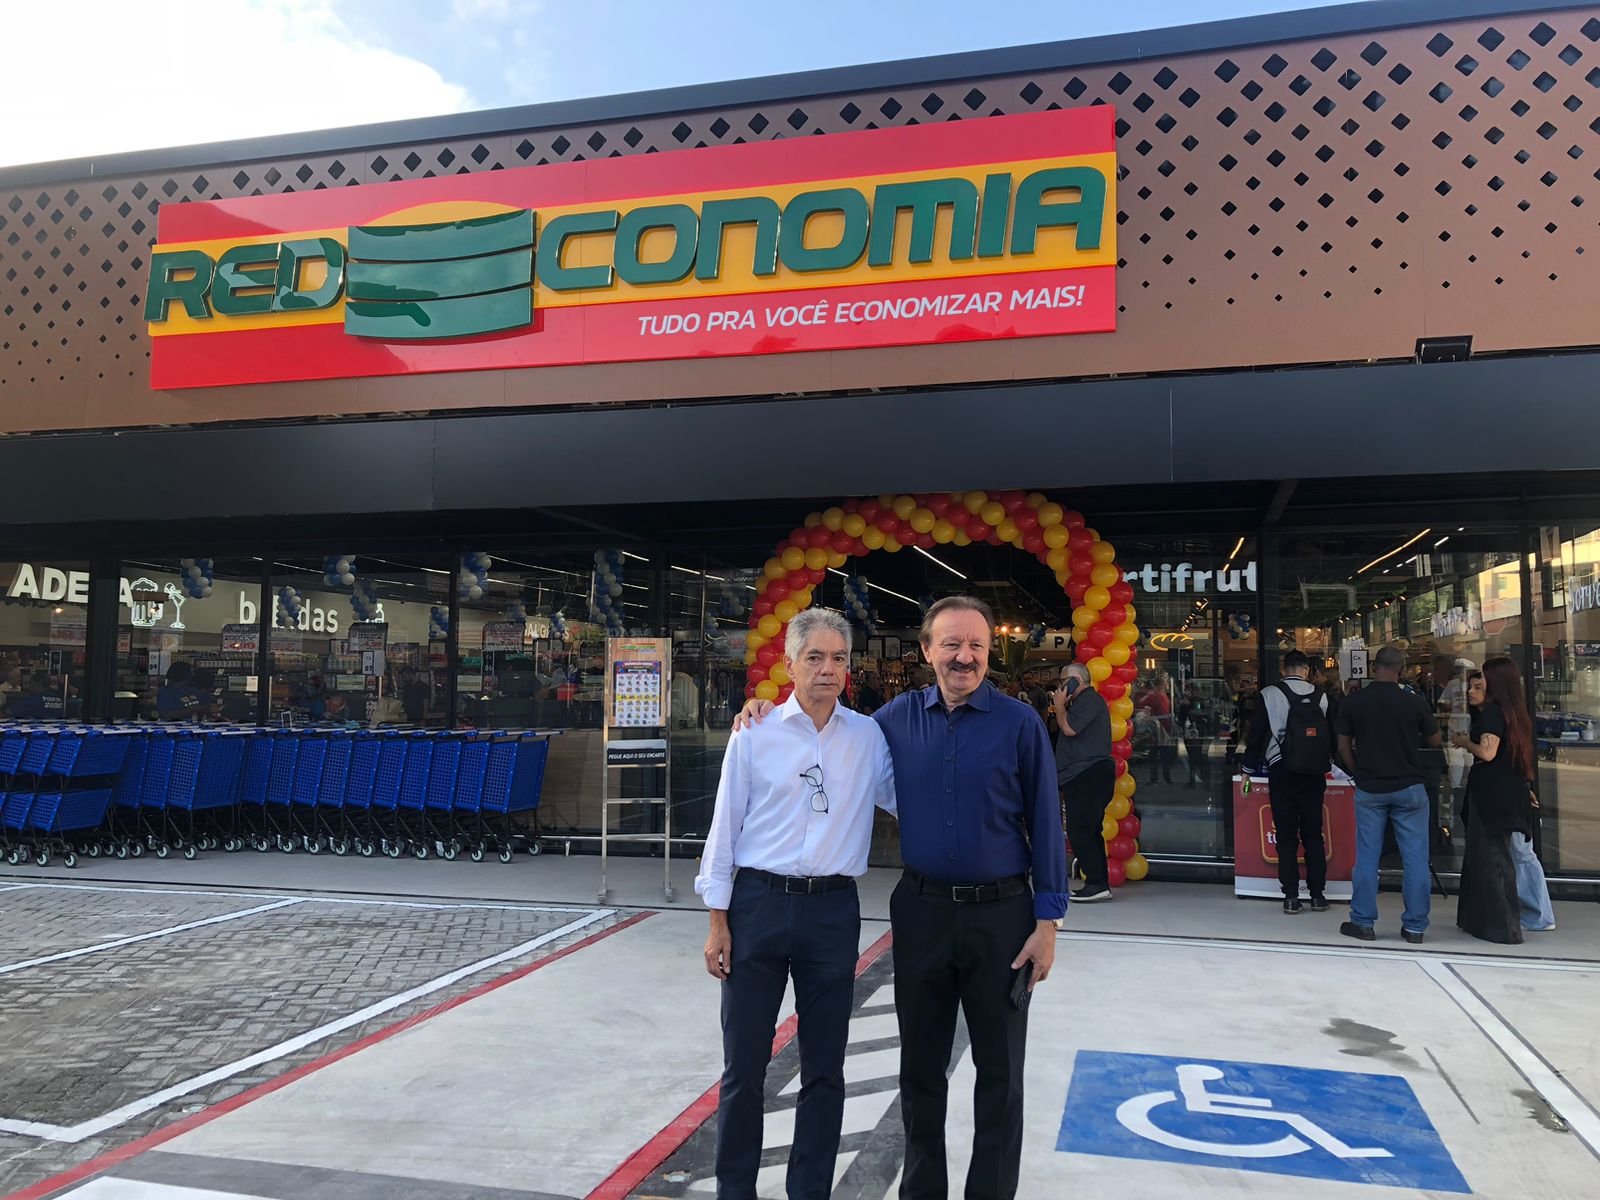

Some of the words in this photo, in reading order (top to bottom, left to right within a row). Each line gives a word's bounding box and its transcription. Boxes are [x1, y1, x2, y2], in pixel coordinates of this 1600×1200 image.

[637, 312, 700, 337] TUDO
[706, 307, 757, 332] PRA
[763, 299, 828, 326] VOCÊ
[833, 291, 1001, 324] ECONOMIZAR
[1008, 284, 1085, 311] MAIS!
[7, 562, 134, 608] ADEA
[1352, 666, 1364, 675] 03
